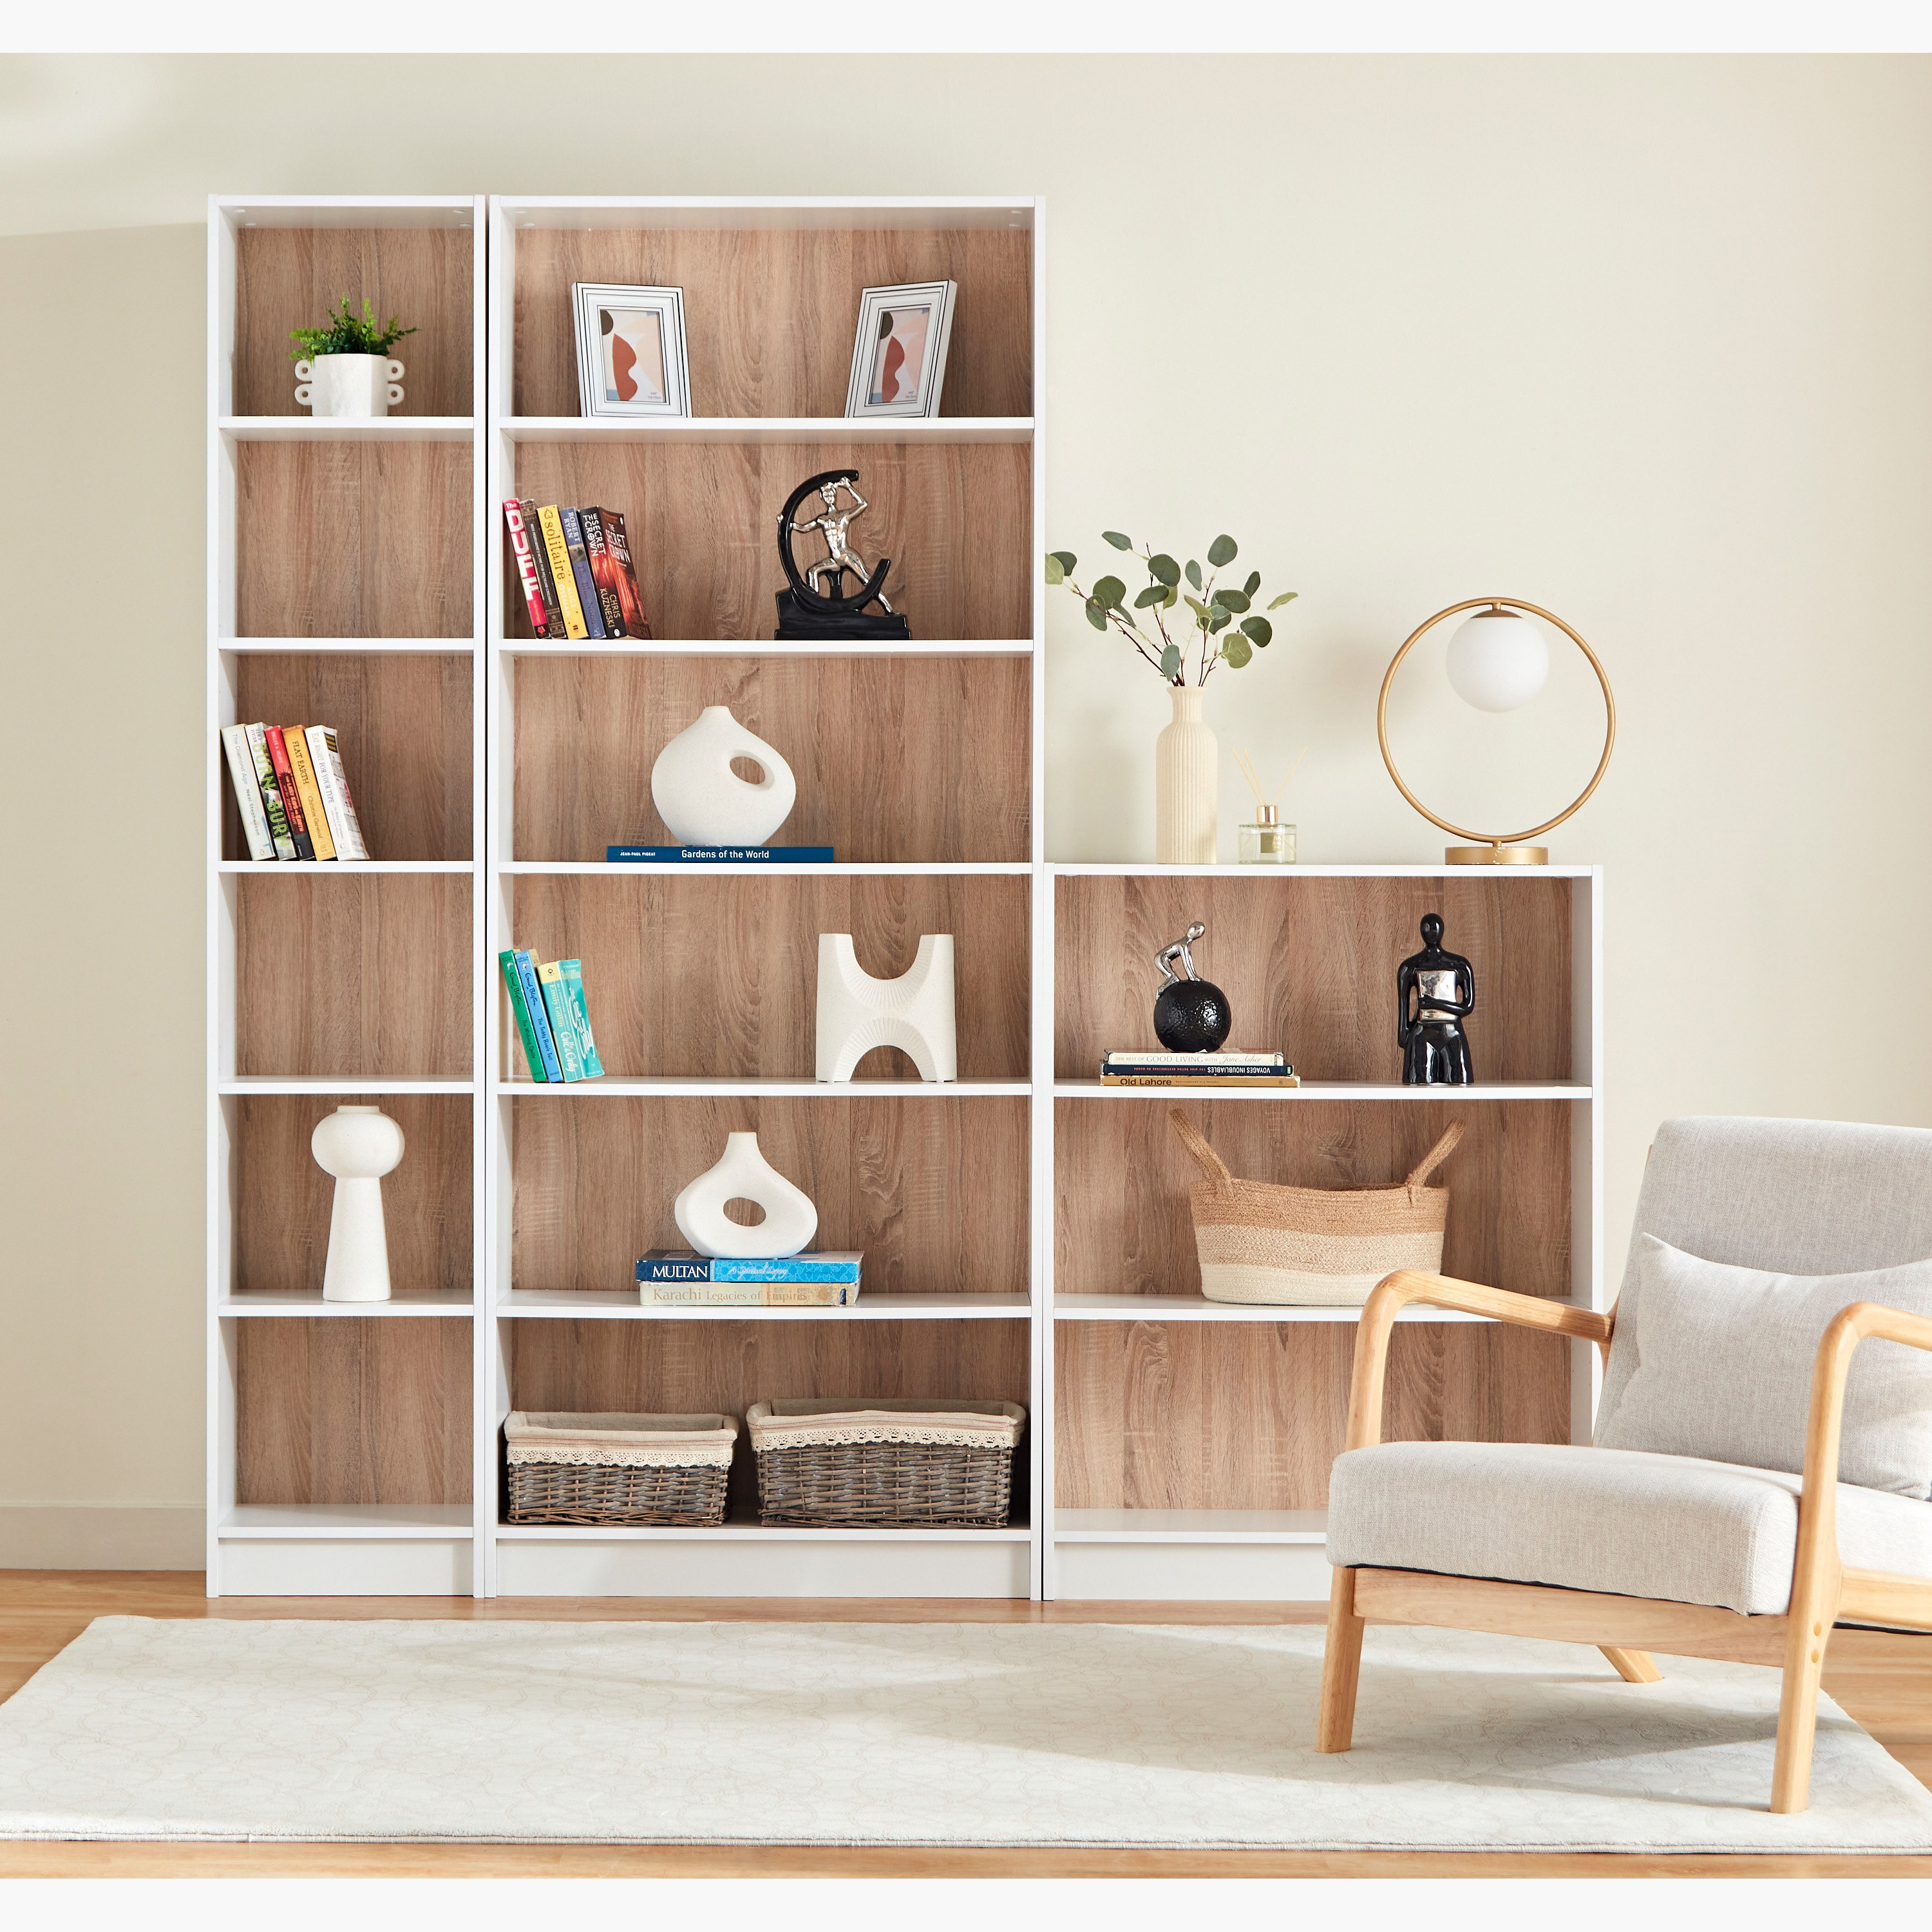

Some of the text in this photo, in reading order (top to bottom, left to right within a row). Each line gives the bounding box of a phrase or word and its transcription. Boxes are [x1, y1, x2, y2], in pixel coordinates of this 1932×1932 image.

[564, 518, 573, 538] RYAN
[567, 511, 580, 542] ROBERT
[584, 520, 598, 556] CROWN
[591, 519, 606, 555] SECRET
[506, 509, 538, 600] DUFF
[544, 520, 566, 580] solitaire
[558, 583, 571, 616] OSEMAN
[566, 586, 576, 607] ALICE
[599, 587, 614, 628] KUZNESKI
[609, 594, 620, 618] CHRIS
[234, 745, 245, 772] Diamond
[252, 743, 276, 790] BURN
[292, 741, 309, 784] FLAT EARTH
[311, 732, 334, 803] EAT RIGHT FOR YOUR TYPE
[248, 802, 260, 835] Stephenson
[290, 796, 298, 809] KIDS
[295, 814, 305, 832] EARTH
[307, 795, 323, 838] Christine Garwood
[745, 850, 769, 858] World
[525, 972, 538, 1006] Enid Blyton
[548, 983, 560, 1006] Emily
[538, 1026, 547, 1038] Teddy
[562, 1051, 578, 1073] Only
[1220, 1055, 1239, 1065] Jane
[652, 1265, 708, 1278] MULTAN
[653, 1288, 807, 1302] Karachi Legacies of Empires
